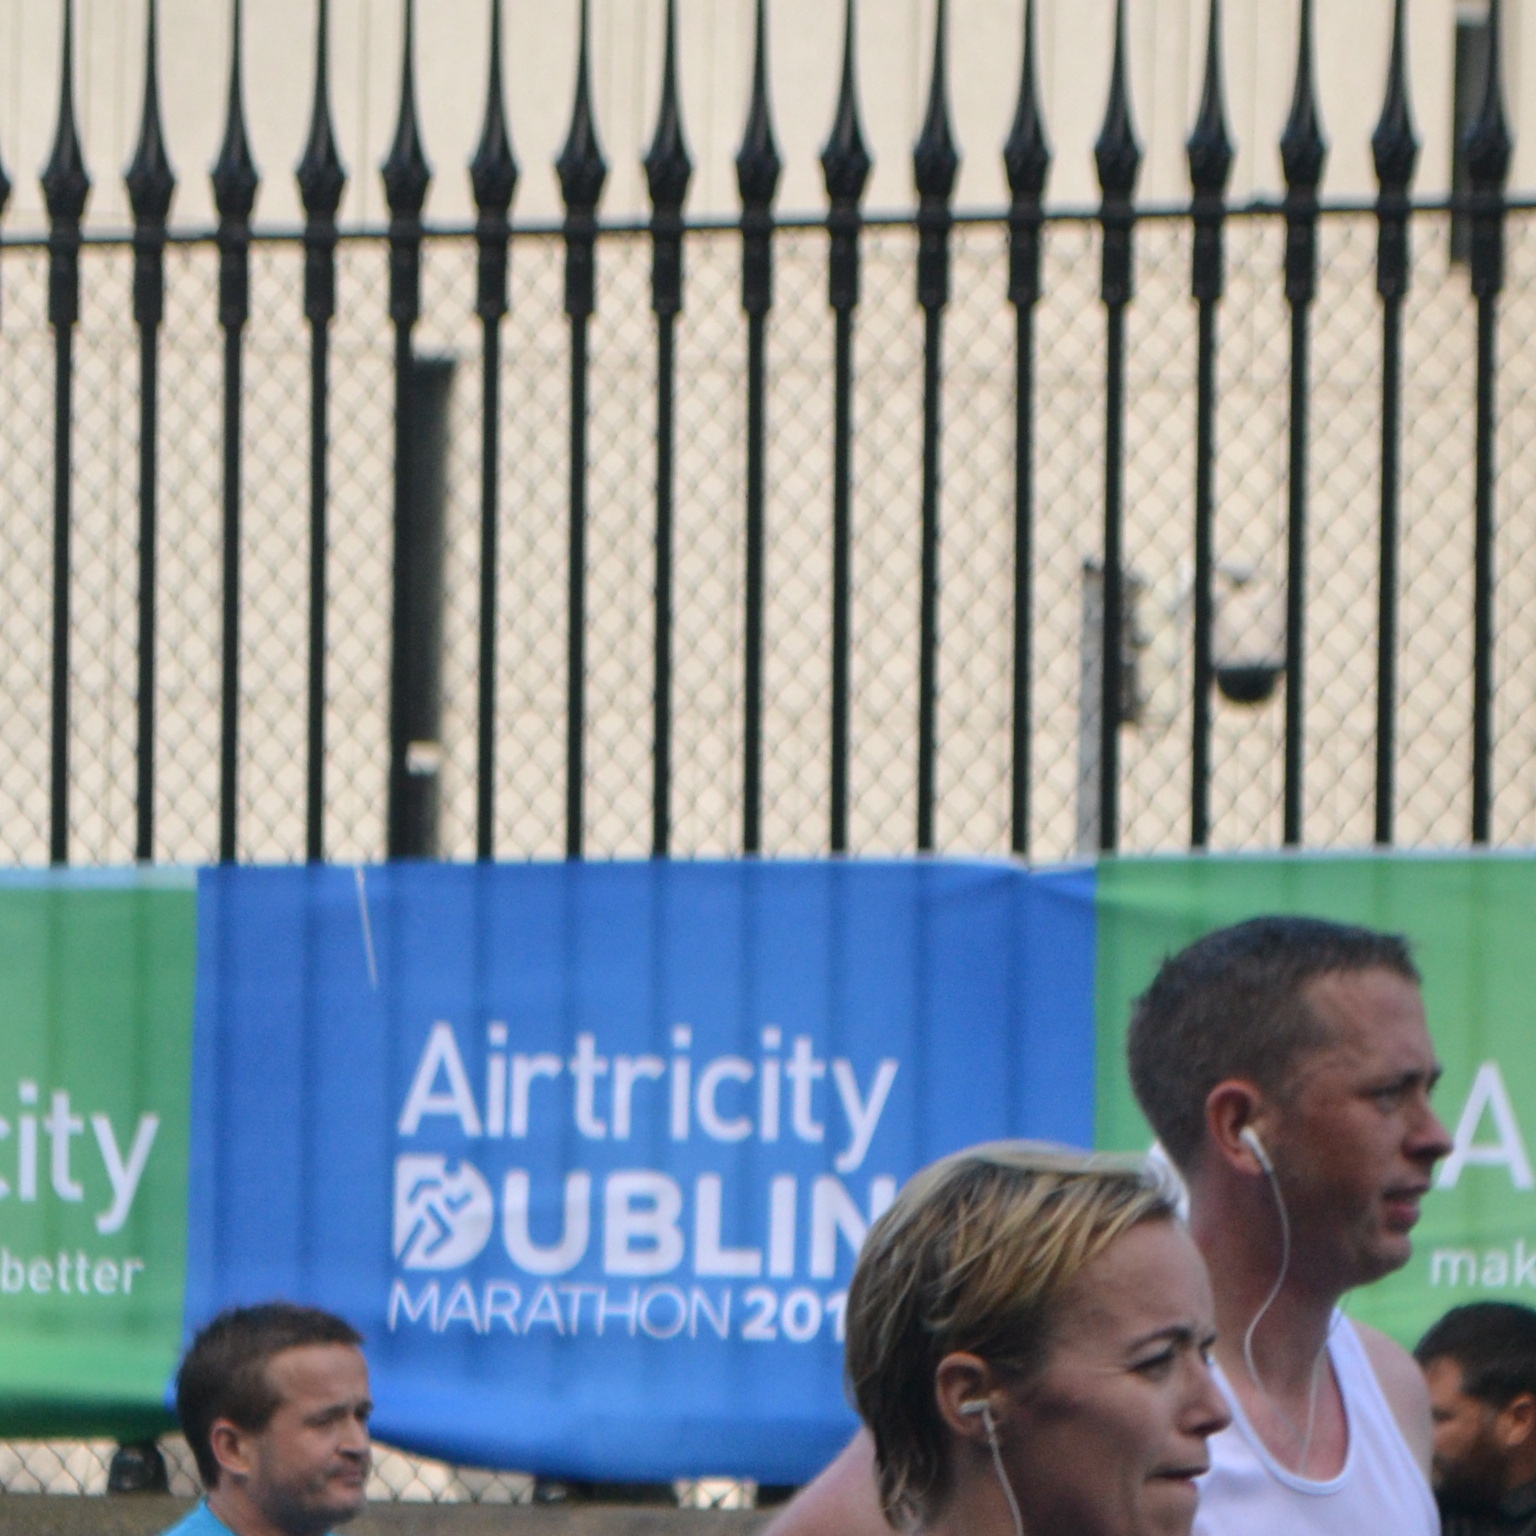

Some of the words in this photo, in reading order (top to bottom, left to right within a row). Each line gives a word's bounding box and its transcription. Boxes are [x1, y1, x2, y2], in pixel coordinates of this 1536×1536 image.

[397, 1020, 899, 1174] Airtricity
[393, 1153, 897, 1279] DUBLIN
[0, 1248, 145, 1295] better
[387, 1279, 730, 1340] MARATHON
[741, 1287, 848, 1343] 201
